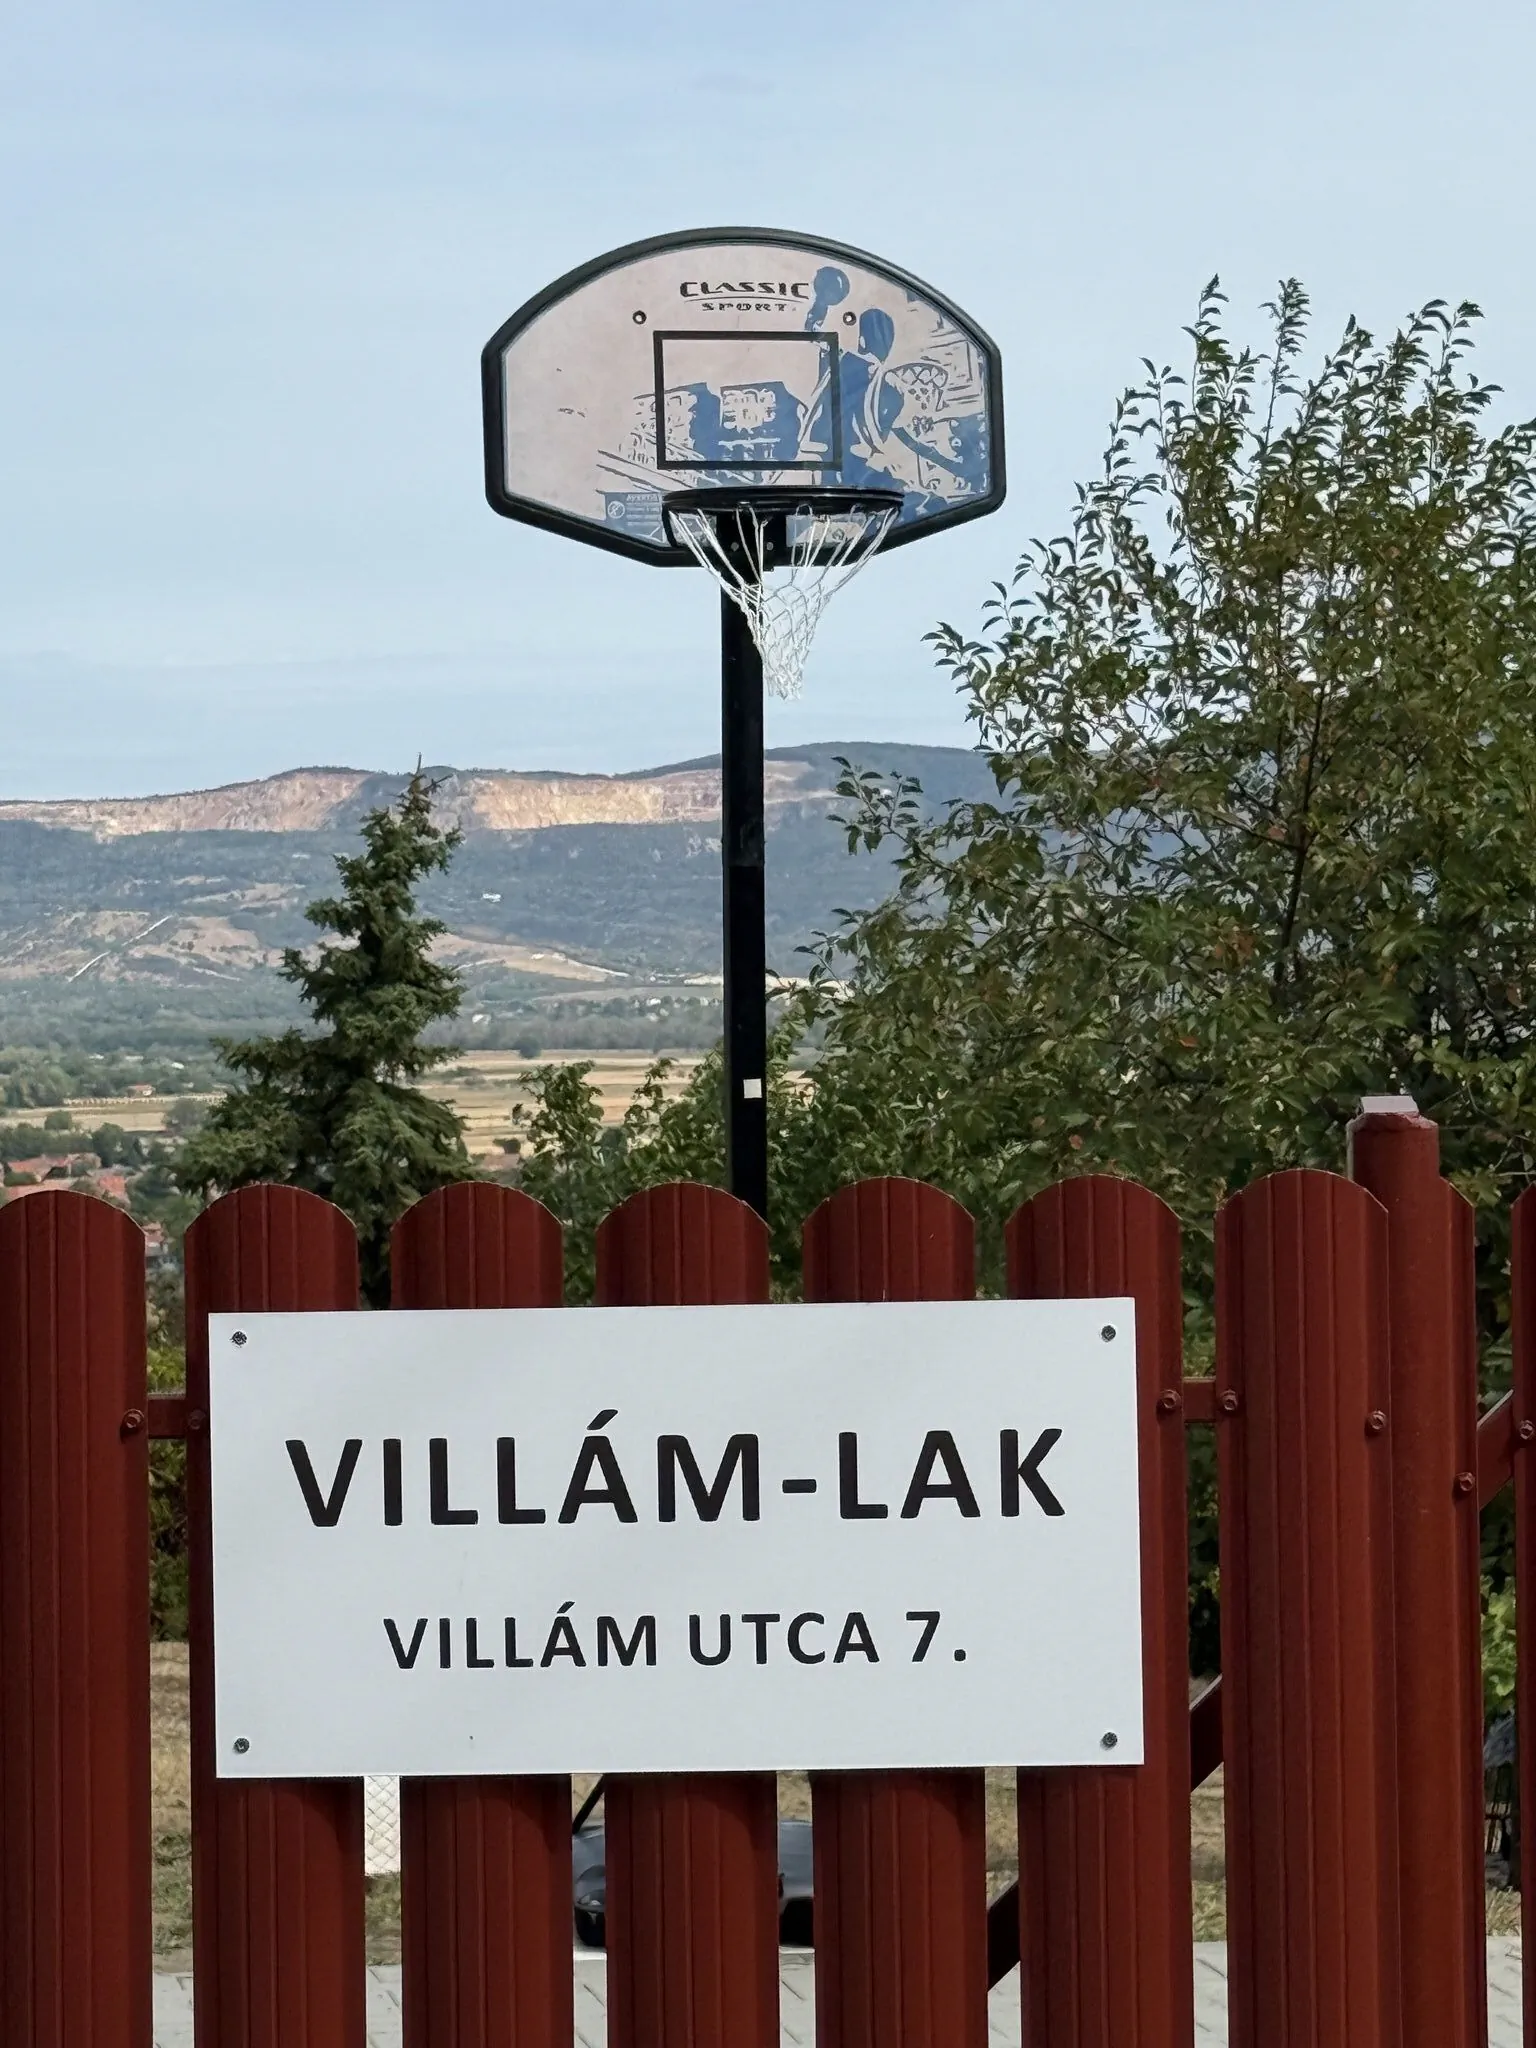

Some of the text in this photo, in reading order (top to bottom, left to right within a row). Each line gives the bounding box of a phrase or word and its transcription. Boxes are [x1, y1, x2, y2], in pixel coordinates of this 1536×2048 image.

[680, 281, 809, 299] CLASSIC
[286, 1410, 1065, 1527] VILLÁM-LAK
[384, 1602, 966, 1669] VILLÁM UTCA 7.
